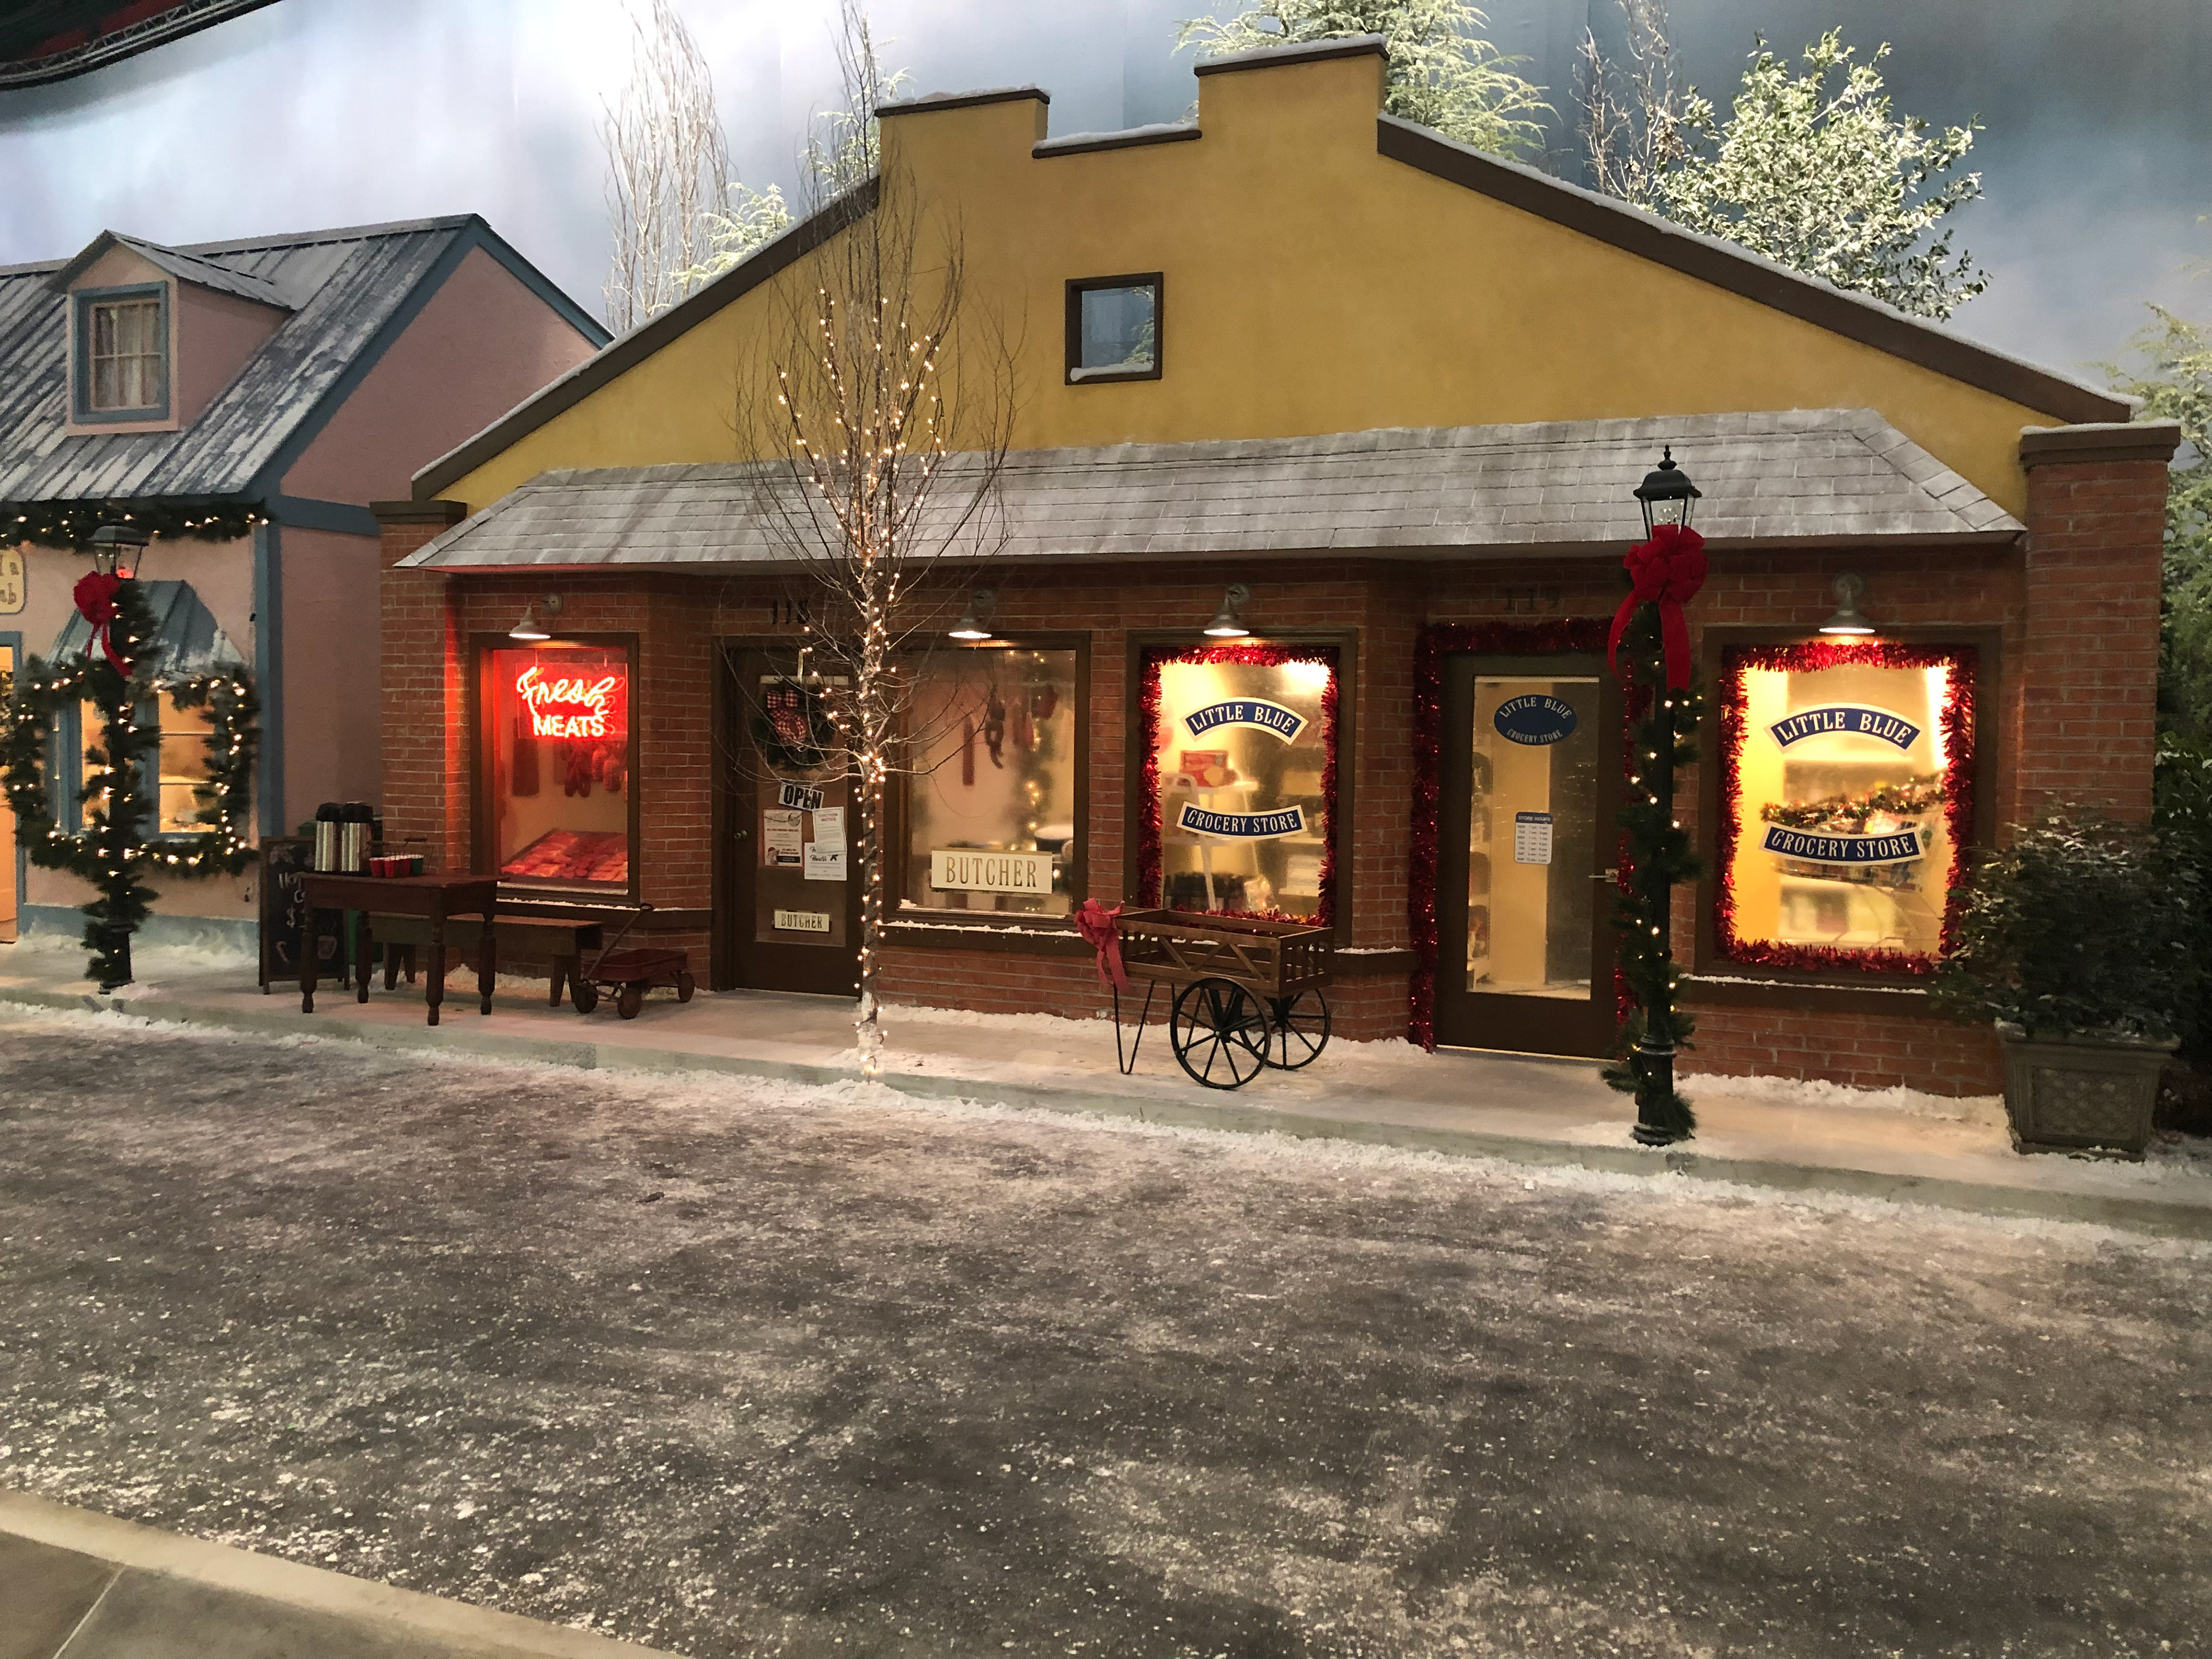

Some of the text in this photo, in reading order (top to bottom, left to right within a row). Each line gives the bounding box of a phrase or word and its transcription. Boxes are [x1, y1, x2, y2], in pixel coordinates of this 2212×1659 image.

[517, 666, 615, 716] Fresh
[1190, 705, 1295, 733] LITTLE BLUE
[1499, 696, 1573, 719] LITTLE BLUE
[533, 714, 604, 737] MEATS
[1507, 729, 1563, 743] GROCERY STORE
[1777, 711, 1912, 743] LITTLE BLUE
[783, 785, 823, 809] OPEN
[1187, 810, 1297, 833] GROCERY STORE
[1771, 831, 1913, 858] GROCERY STORE
[946, 856, 1036, 888] BUTCHER
[781, 913, 822, 929] BUTCHER
